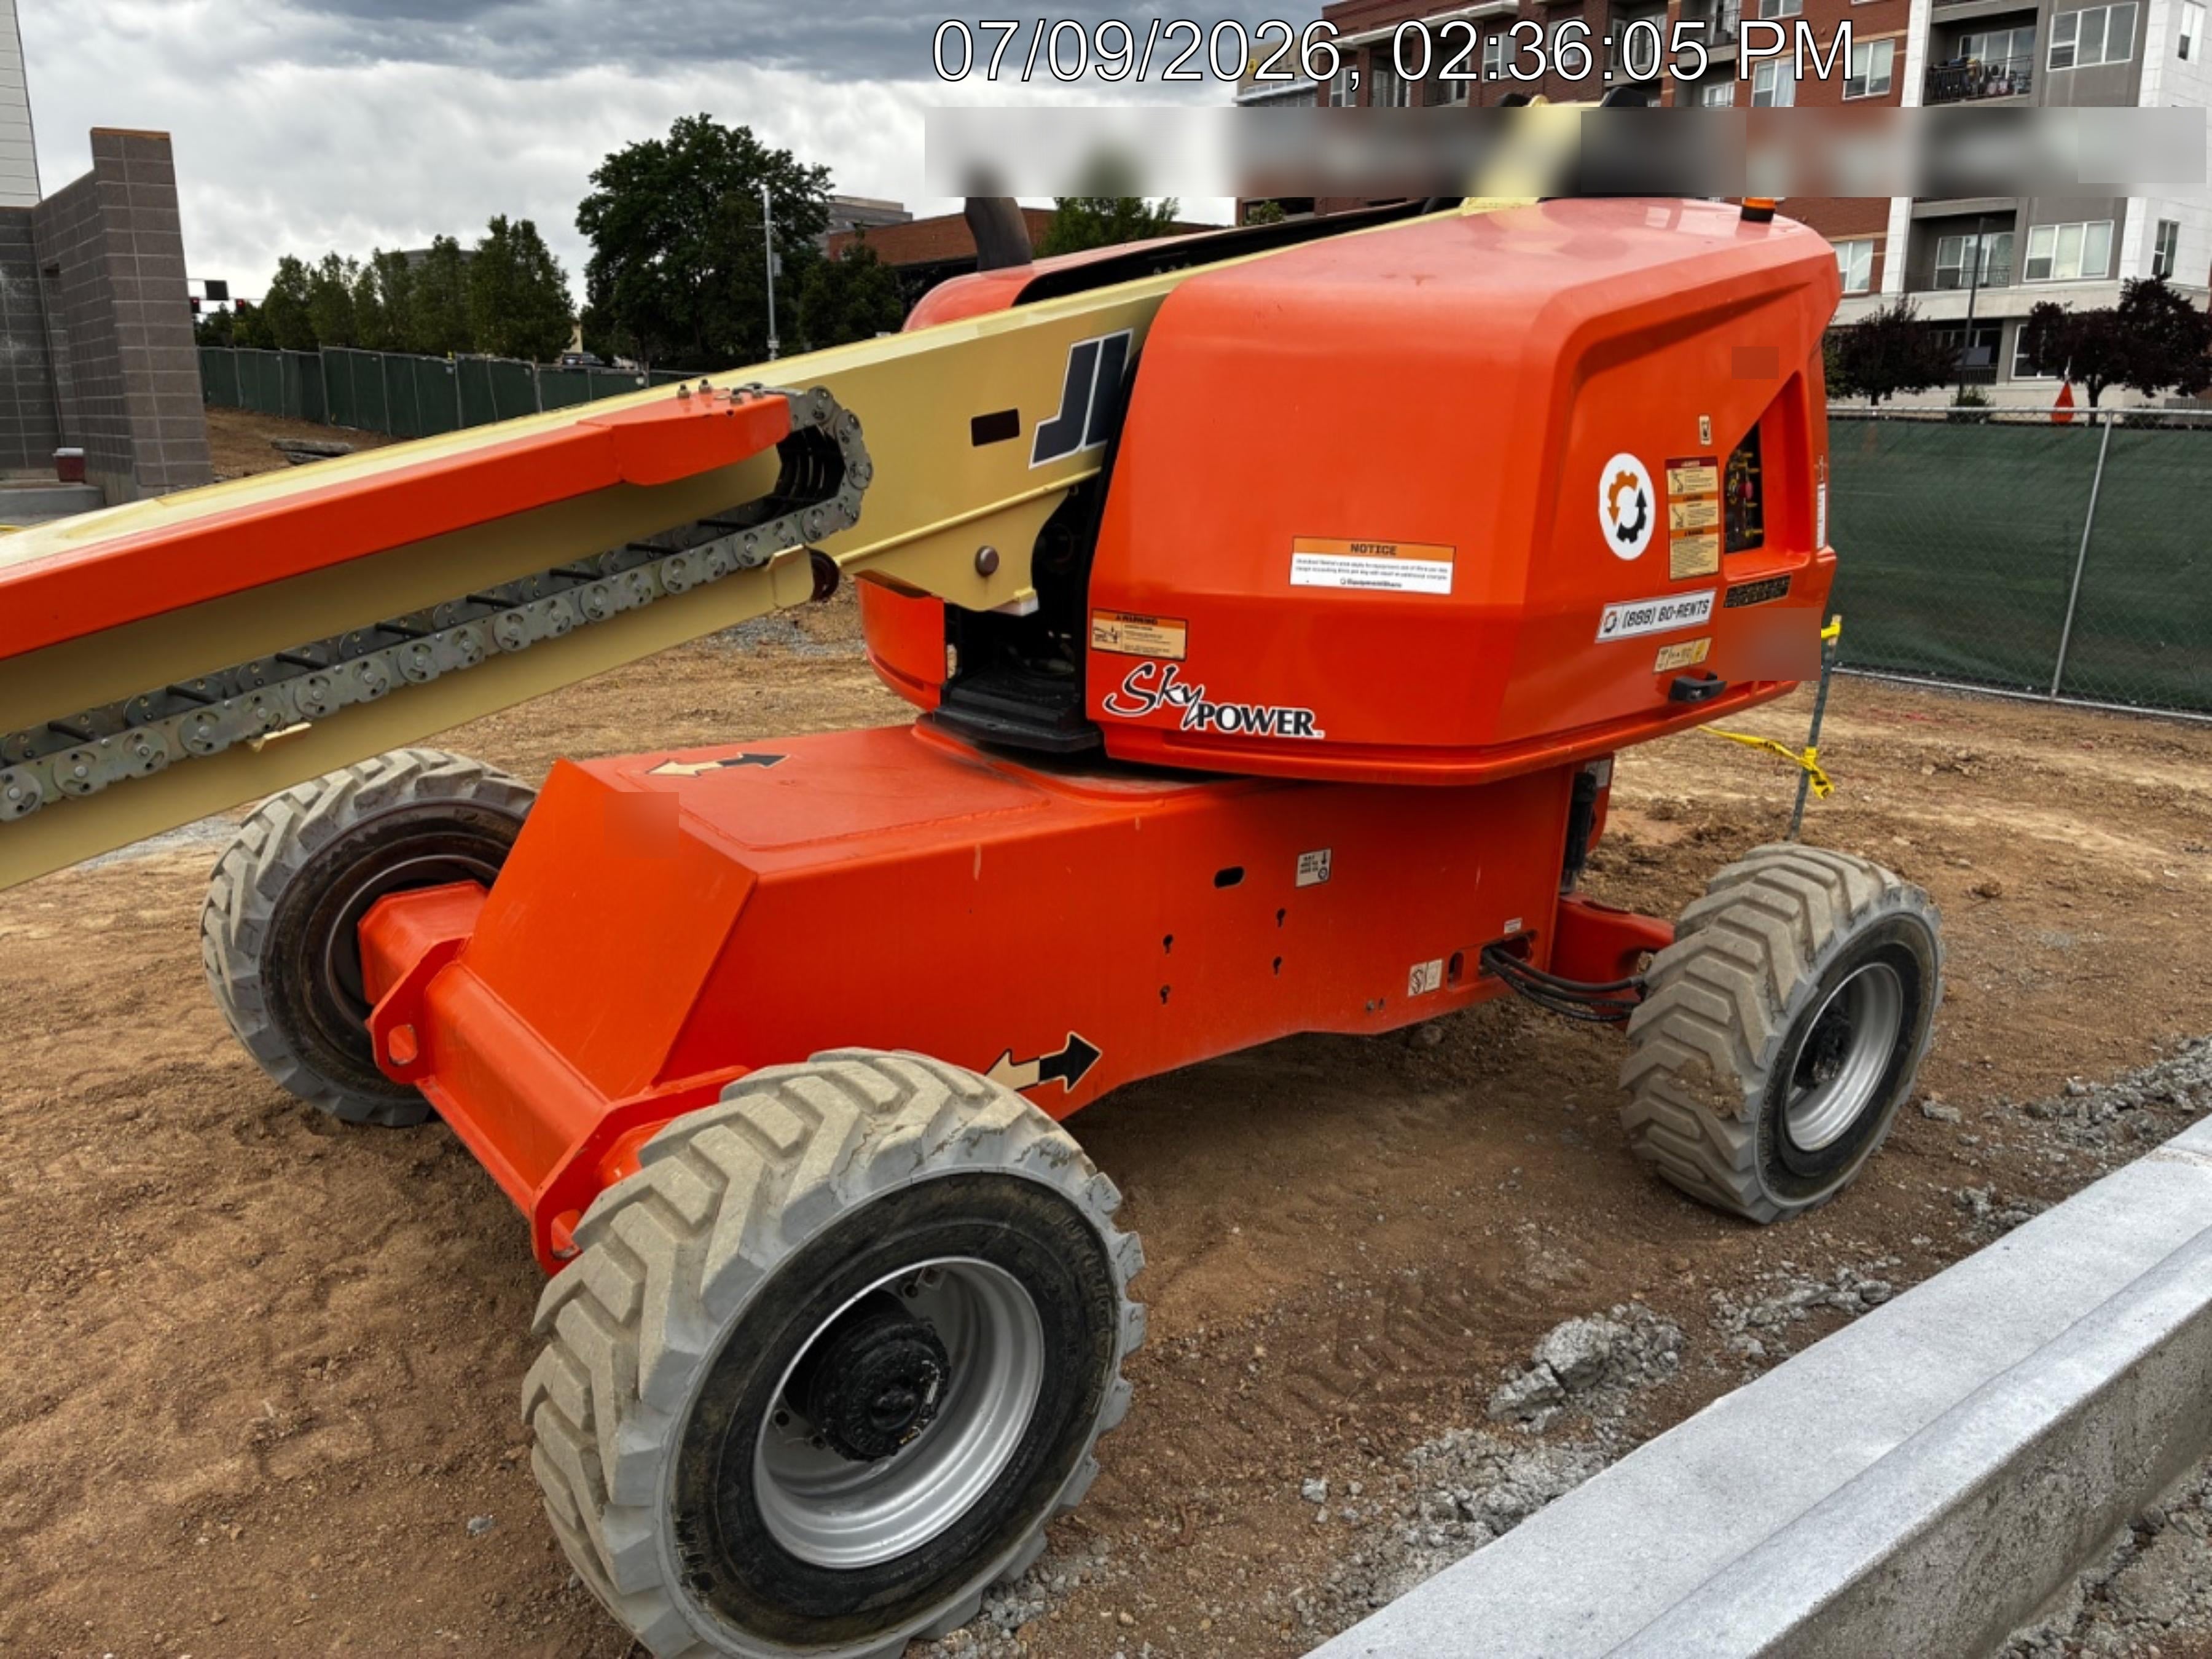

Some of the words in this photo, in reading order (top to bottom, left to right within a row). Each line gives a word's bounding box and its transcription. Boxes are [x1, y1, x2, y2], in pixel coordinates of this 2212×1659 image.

[1350, 543, 1398, 556] NOTICE
[1104, 661, 1205, 731] Sky
[1196, 702, 1316, 737] POWER
